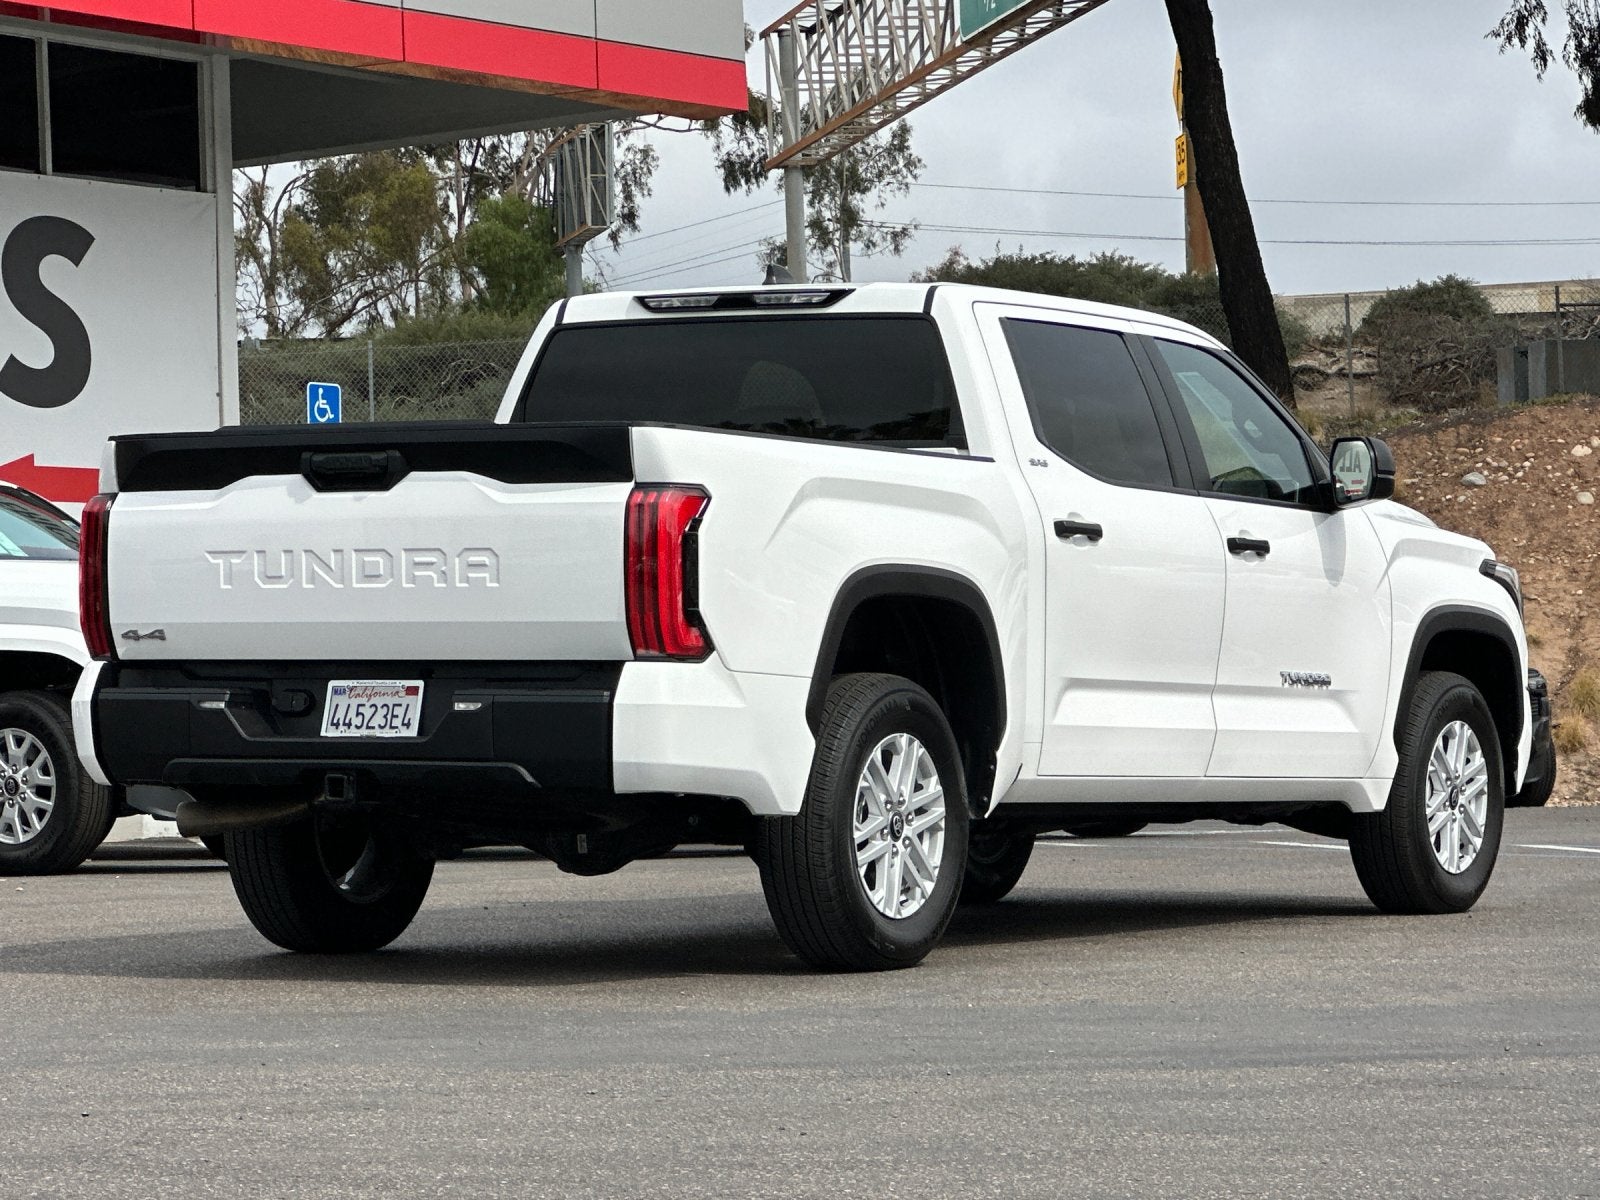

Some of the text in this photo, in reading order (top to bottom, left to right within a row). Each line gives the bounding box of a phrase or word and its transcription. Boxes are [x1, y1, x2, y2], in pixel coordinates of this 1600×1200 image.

[0, 215, 96, 409] S
[204, 547, 500, 589] TUNDRA
[347, 686, 406, 702] California
[330, 703, 412, 730] 44523E4
